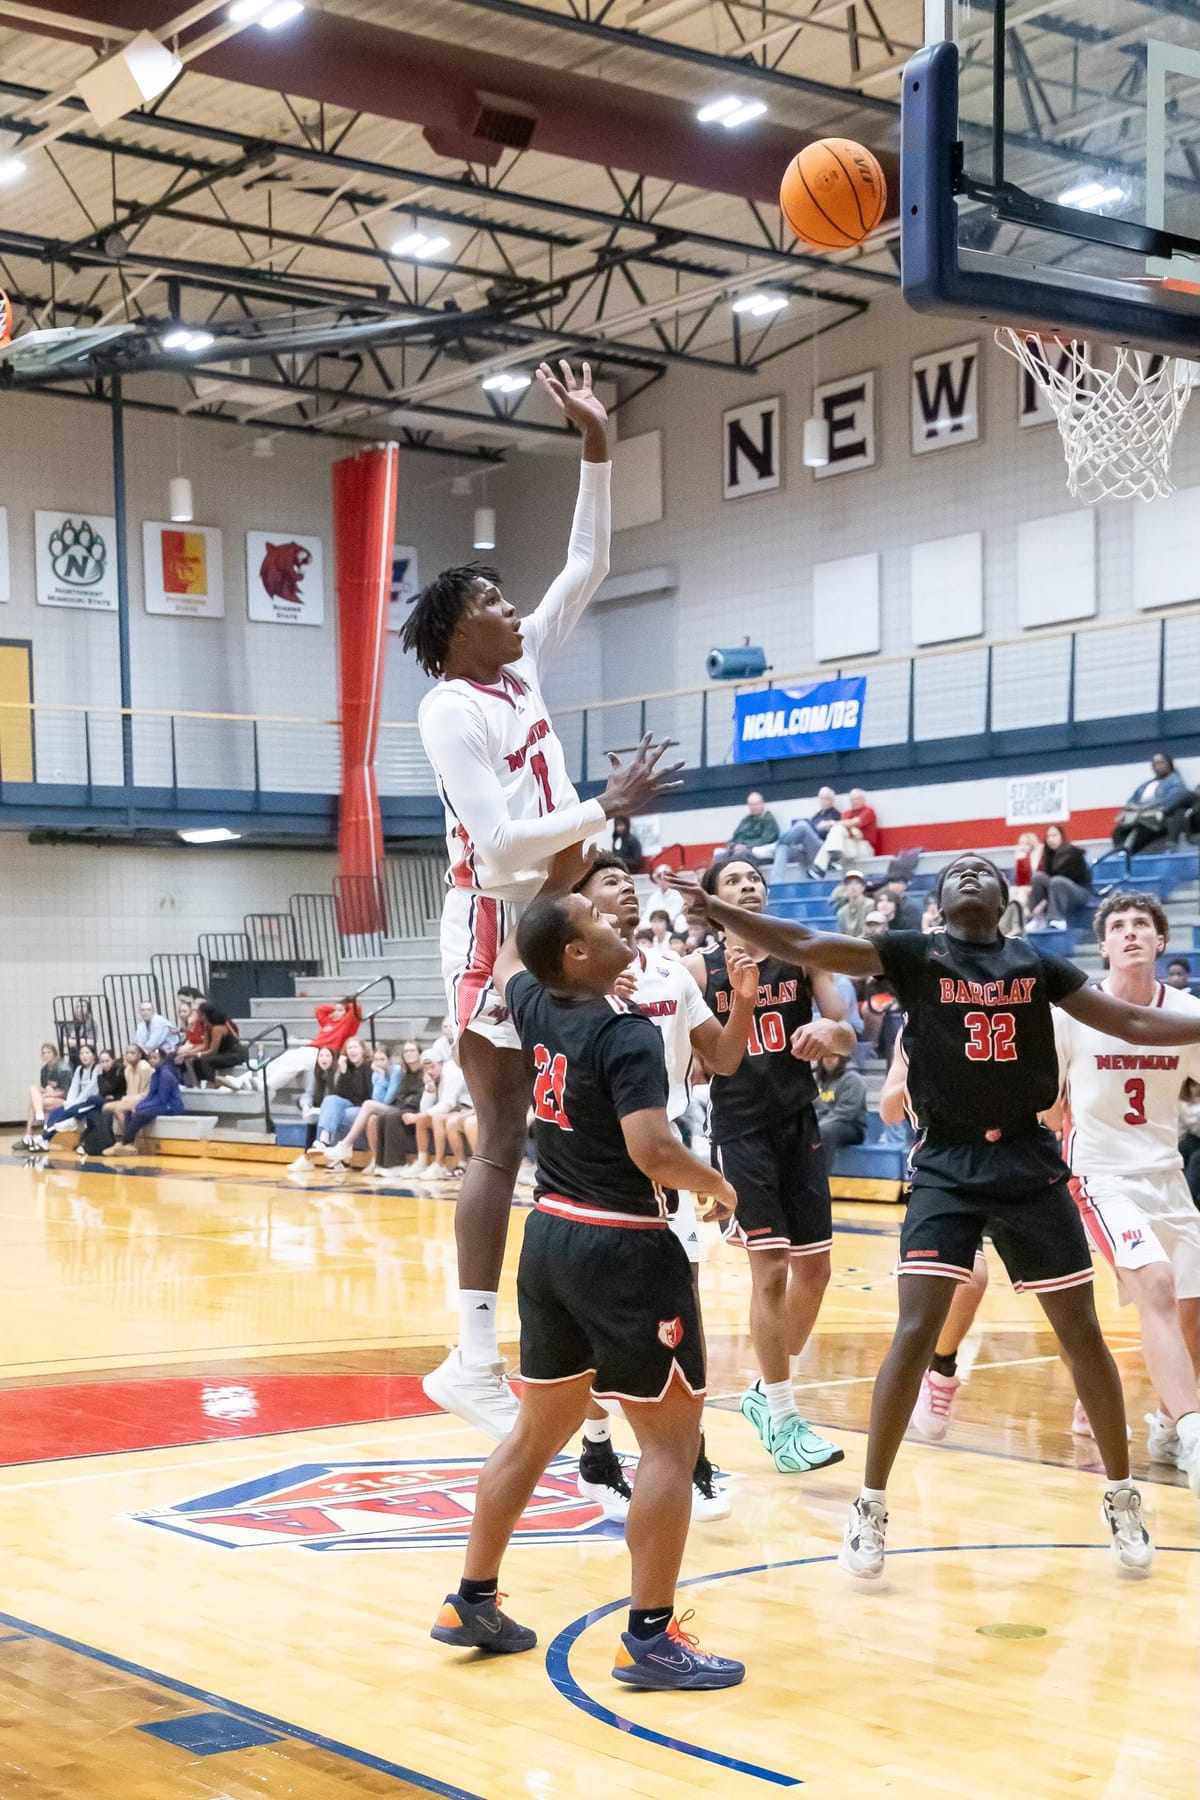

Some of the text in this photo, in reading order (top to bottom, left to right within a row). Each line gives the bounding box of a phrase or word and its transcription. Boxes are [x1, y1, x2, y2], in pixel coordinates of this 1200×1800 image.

[727, 340, 1164, 486] NEWM
[742, 700, 860, 742] NCAA.COM/D2
[1012, 797, 1062, 817] SECTION
[715, 979, 798, 1013] BCLAY
[939, 978, 1036, 1006] BARCLAY
[747, 1011, 787, 1057] 10
[965, 1012, 1018, 1062] 32
[1094, 1055, 1180, 1070] NEWMAN
[533, 1043, 575, 1132] 21
[1123, 1077, 1148, 1125] 3
[316, 1471, 445, 1495] 1912
